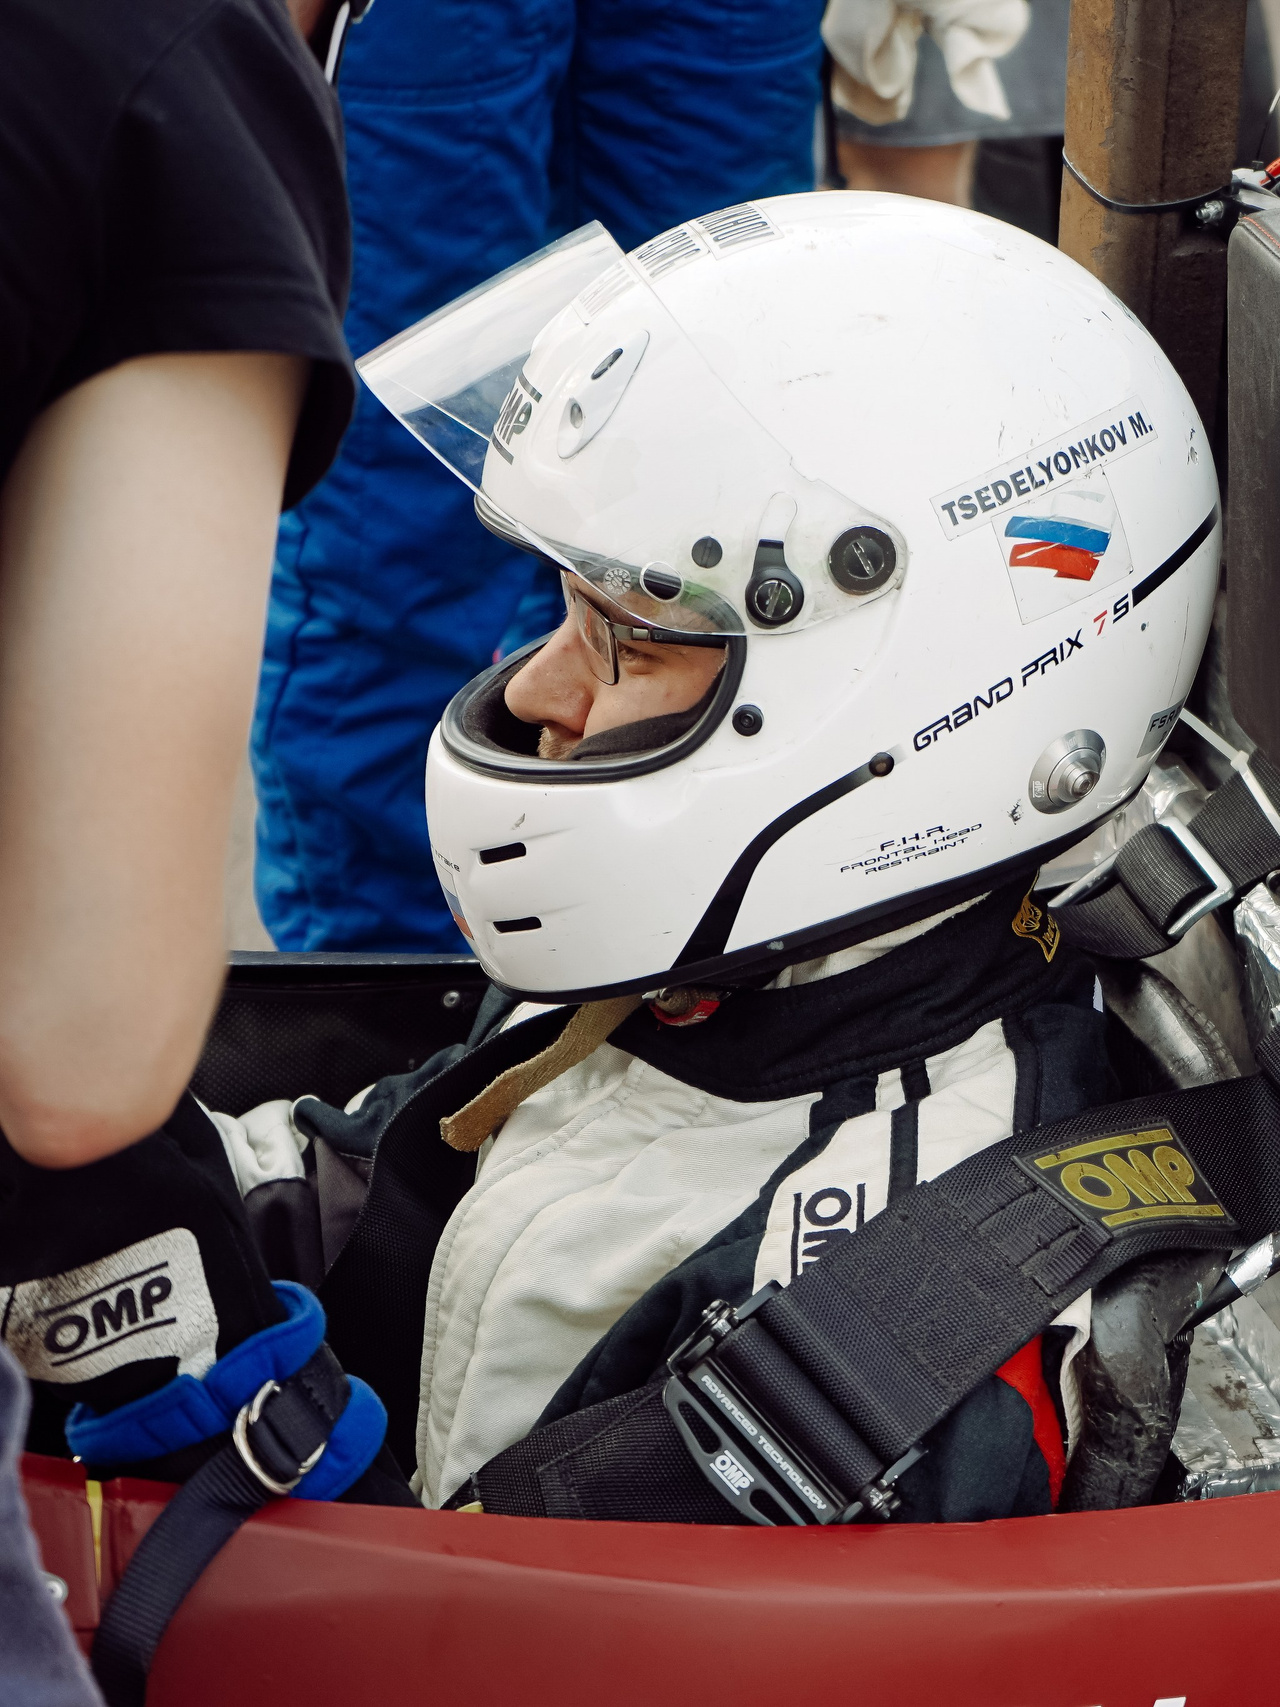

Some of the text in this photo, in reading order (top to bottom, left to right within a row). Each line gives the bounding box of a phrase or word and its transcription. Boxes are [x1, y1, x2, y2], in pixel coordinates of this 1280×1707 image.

[941, 411, 1153, 526] TSEDELYONKOV M.
[1021, 628, 1083, 687] PRIX
[880, 825, 950, 851] F.H.R.
[1061, 1146, 1196, 1209] OMP
[44, 1276, 172, 1354] OMP
[715, 1455, 750, 1489] OMP
